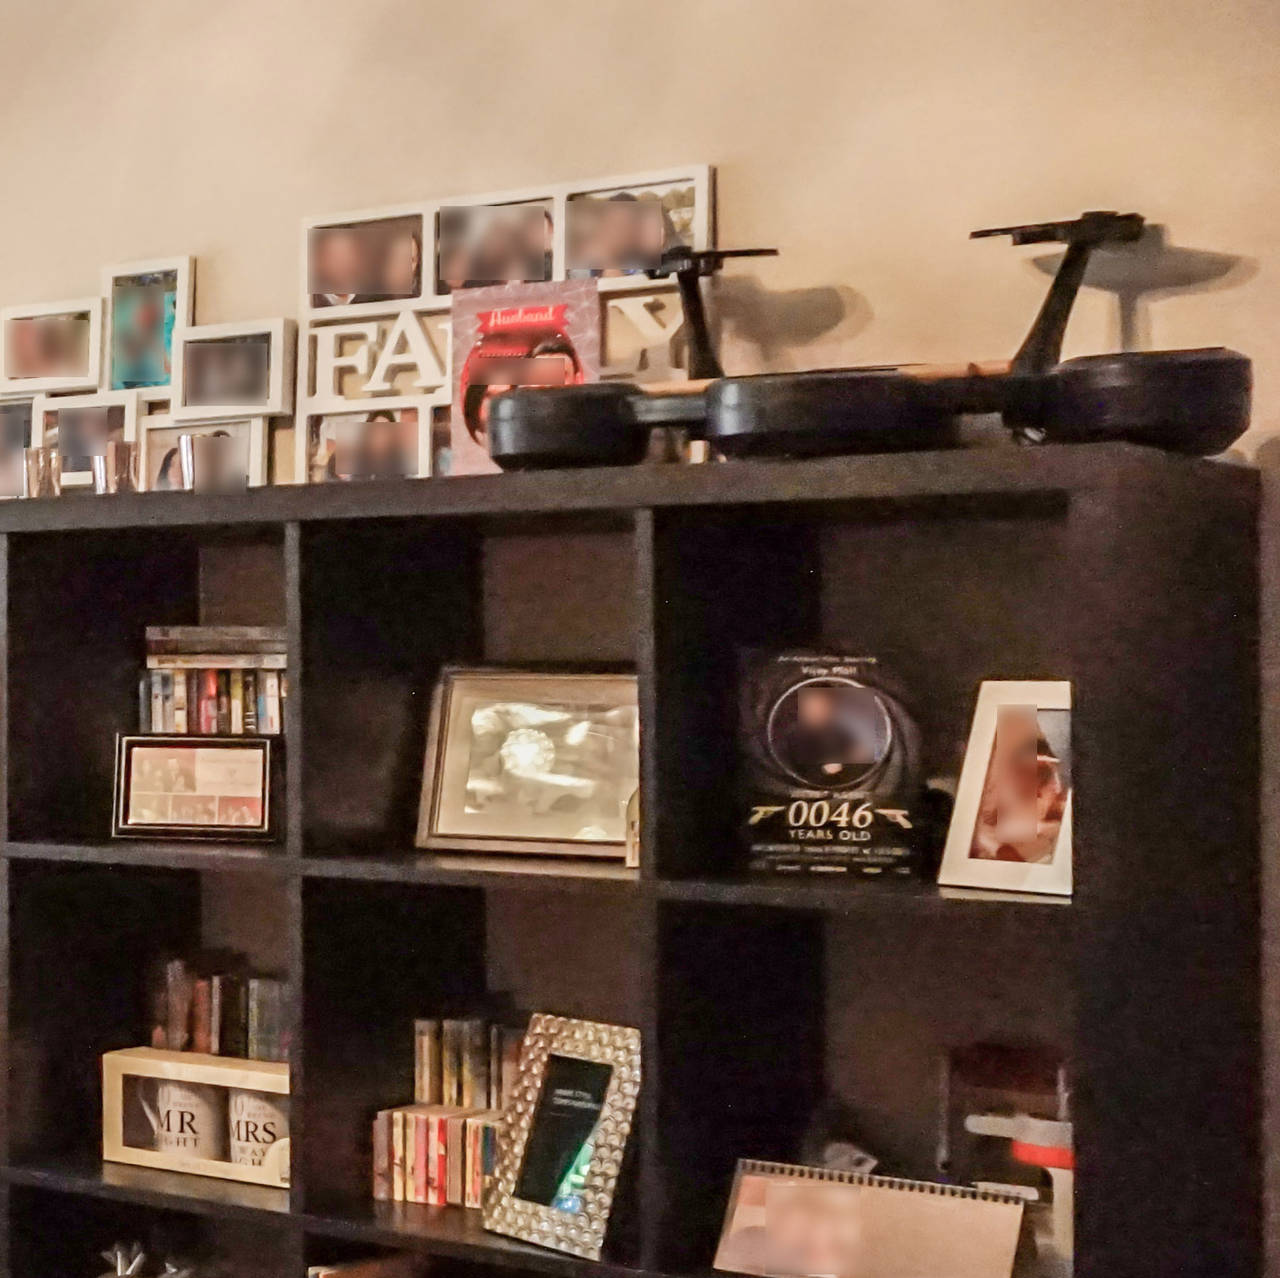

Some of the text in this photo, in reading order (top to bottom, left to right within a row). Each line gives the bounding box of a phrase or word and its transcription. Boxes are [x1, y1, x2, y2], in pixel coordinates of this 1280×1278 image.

[788, 800, 873, 828] 0046
[789, 829, 872, 842] YEARS OLD
[231, 1120, 277, 1144] MRS
